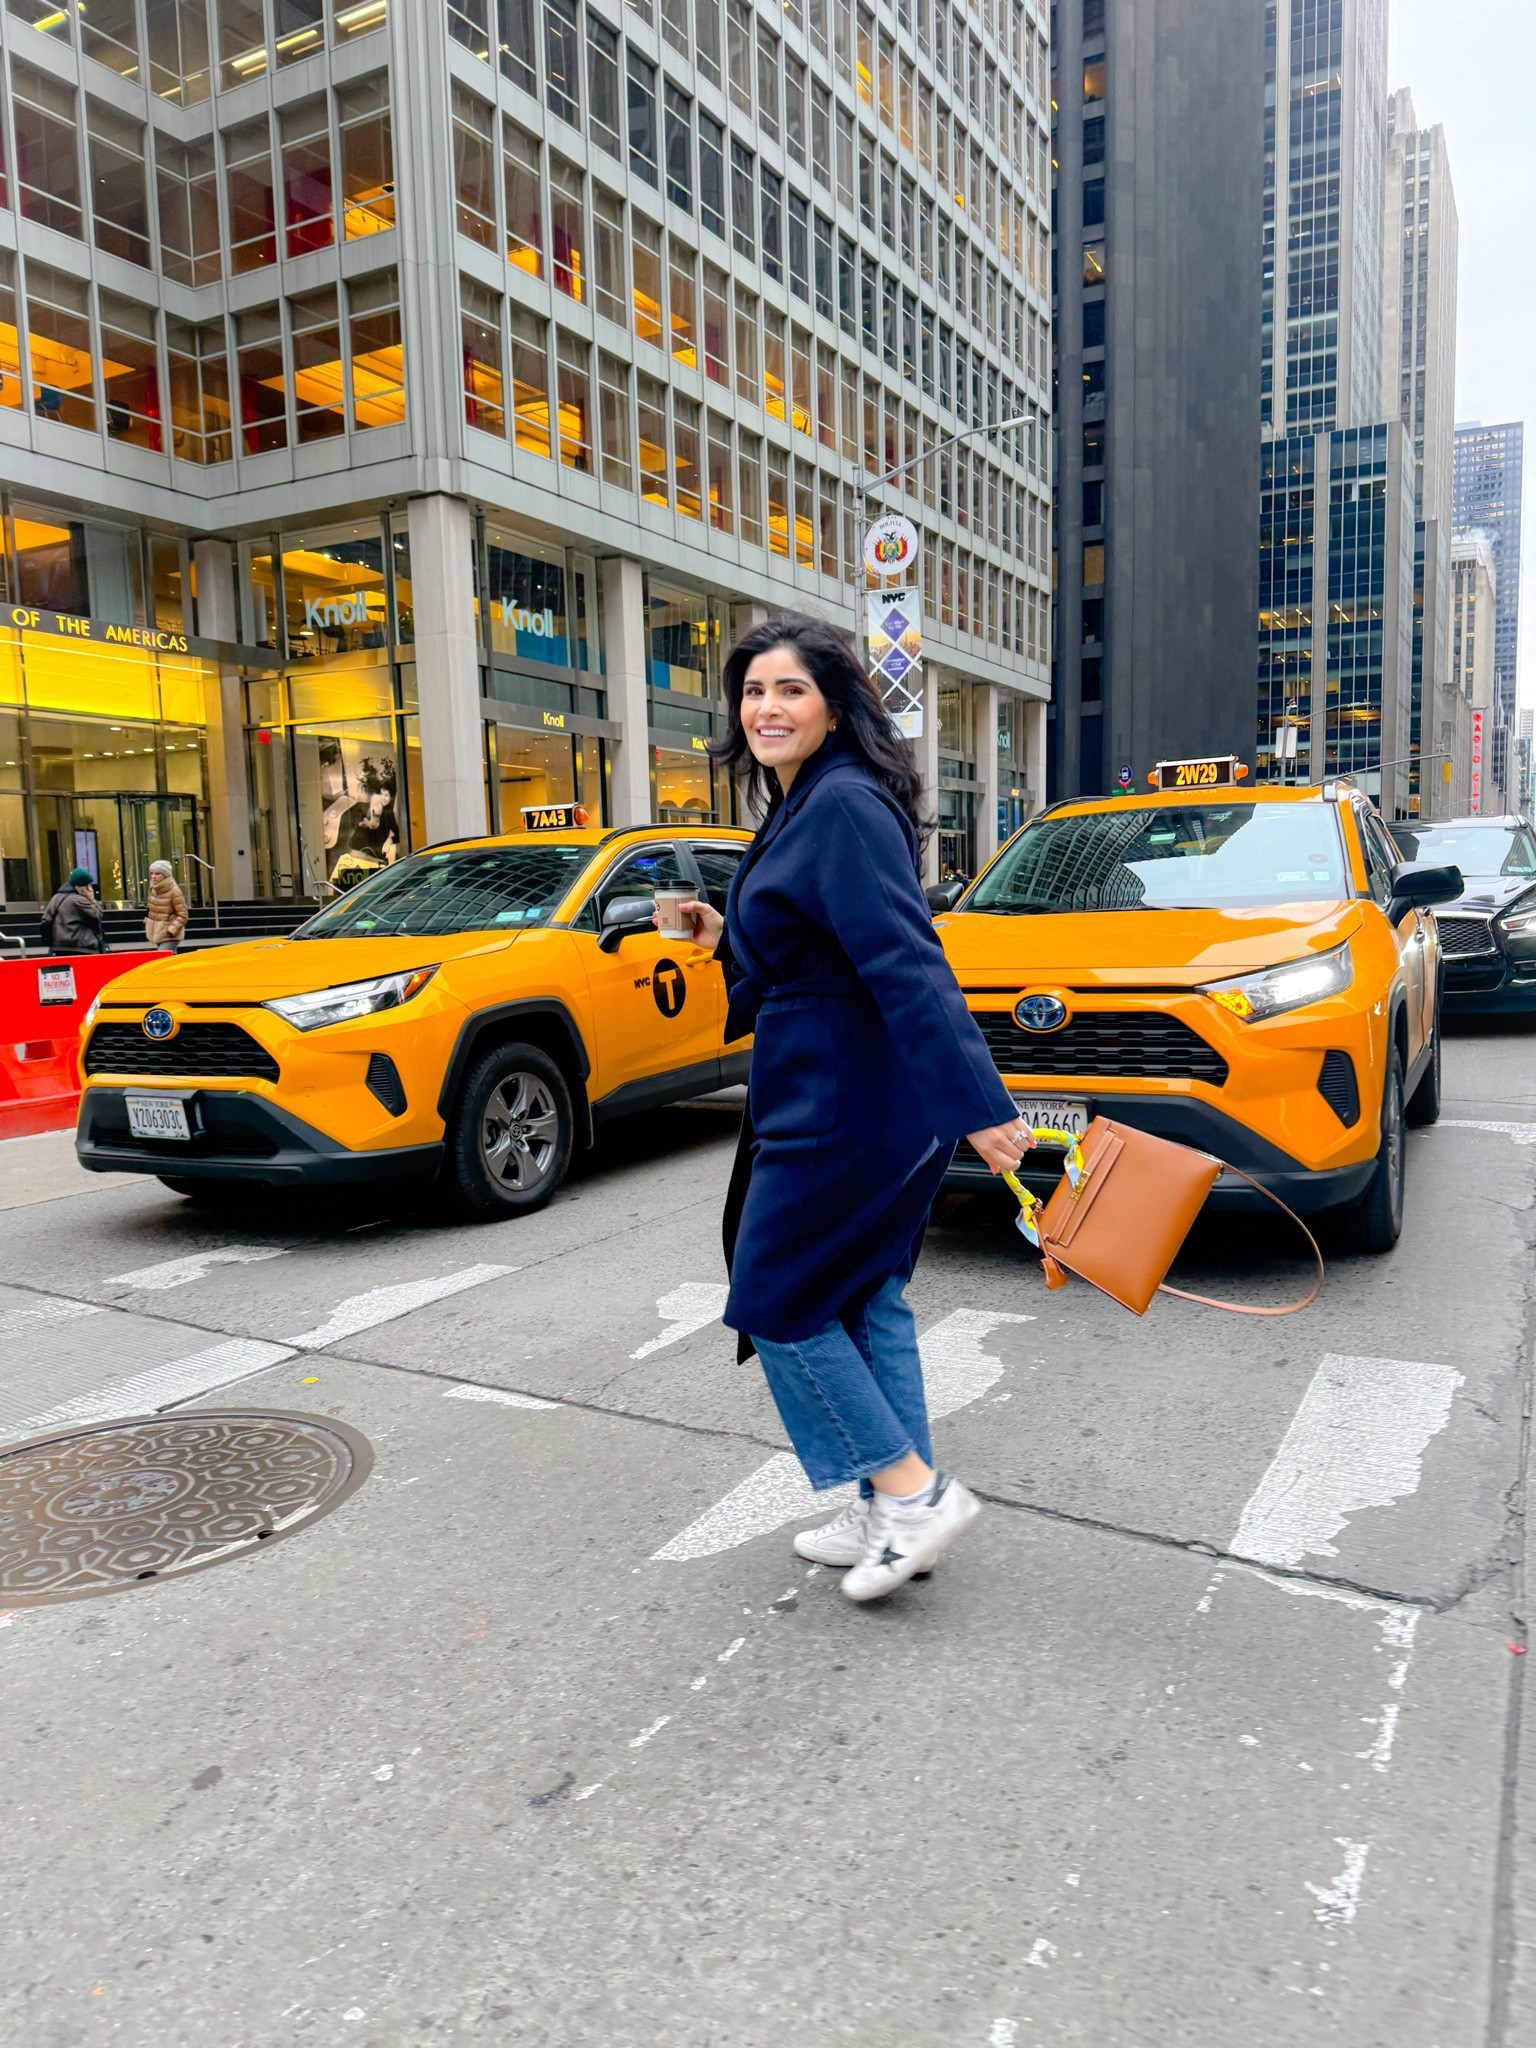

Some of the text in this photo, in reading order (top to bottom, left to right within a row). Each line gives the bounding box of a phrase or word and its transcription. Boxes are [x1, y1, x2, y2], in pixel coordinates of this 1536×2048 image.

[882, 592, 906, 604] NYC
[305, 590, 368, 629] Knoll
[502, 596, 554, 639] Knoll
[12, 608, 188, 653] OF THE AMERICAS
[543, 712, 565, 728] Knoll
[1176, 763, 1218, 785] 2W29
[531, 809, 566, 828] 7A43
[633, 969, 677, 1010] NYC T
[1017, 1101, 1065, 1110] NEW YORK
